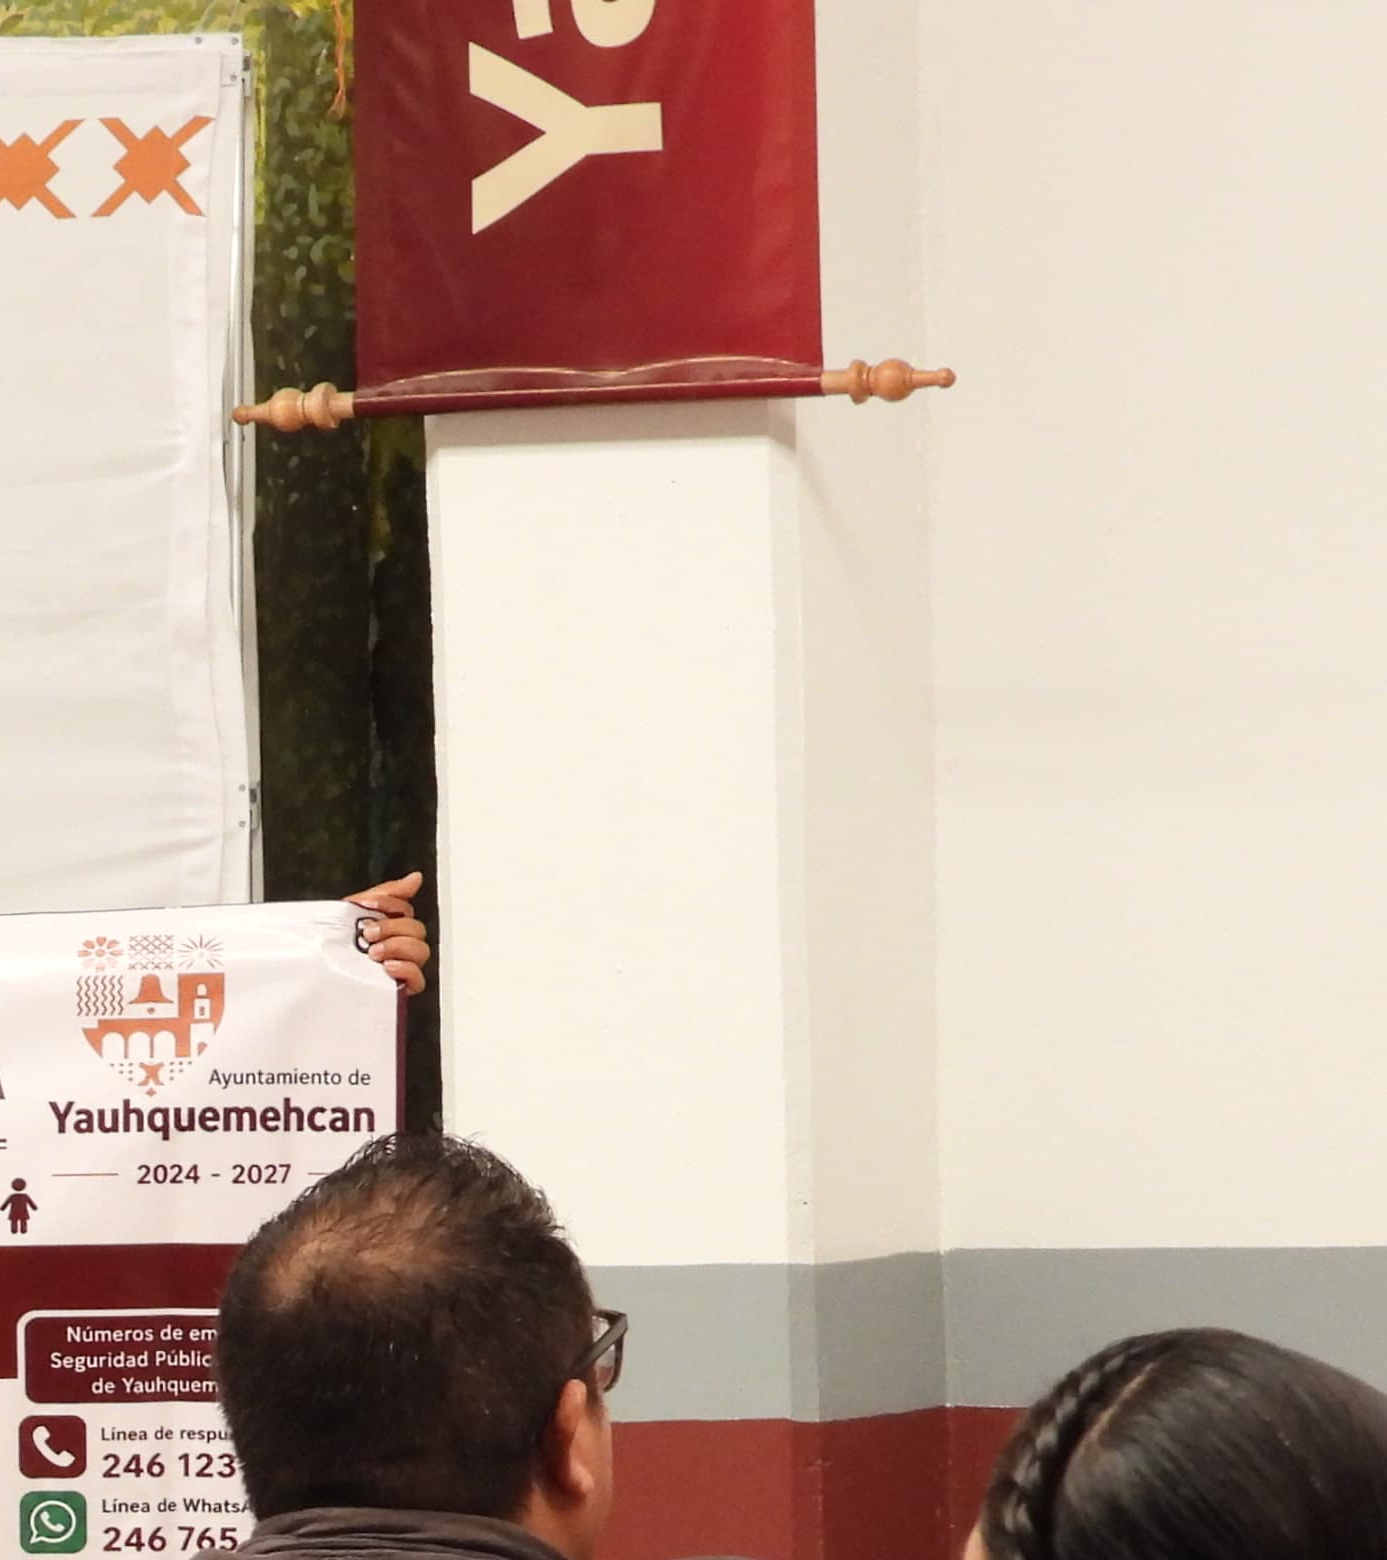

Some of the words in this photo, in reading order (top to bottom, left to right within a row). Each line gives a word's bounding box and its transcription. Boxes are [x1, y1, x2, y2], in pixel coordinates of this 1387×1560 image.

[208, 1067, 343, 1089] Ayuntamiento
[348, 1067, 372, 1086] de
[48, 1097, 376, 1141] Yauhquemehcan
[136, 1163, 201, 1185] 2024
[231, 1163, 293, 1185] 2027
[66, 1324, 154, 1343] Números
[160, 1322, 184, 1341] de
[49, 1351, 149, 1373] Seguridad
[155, 1349, 213, 1367] Públic
[91, 1377, 116, 1394] de
[122, 1376, 220, 1397] Yauhquem
[100, 1426, 148, 1441] Línea
[154, 1425, 174, 1441] de
[179, 1428, 230, 1444] respu
[101, 1452, 166, 1478] 246
[177, 1452, 237, 1478] 123
[101, 1498, 151, 1514] Línea
[157, 1498, 177, 1513] de
[182, 1498, 251, 1514] WhatsA
[102, 1526, 168, 1552] 246
[177, 1525, 239, 1551] 765
